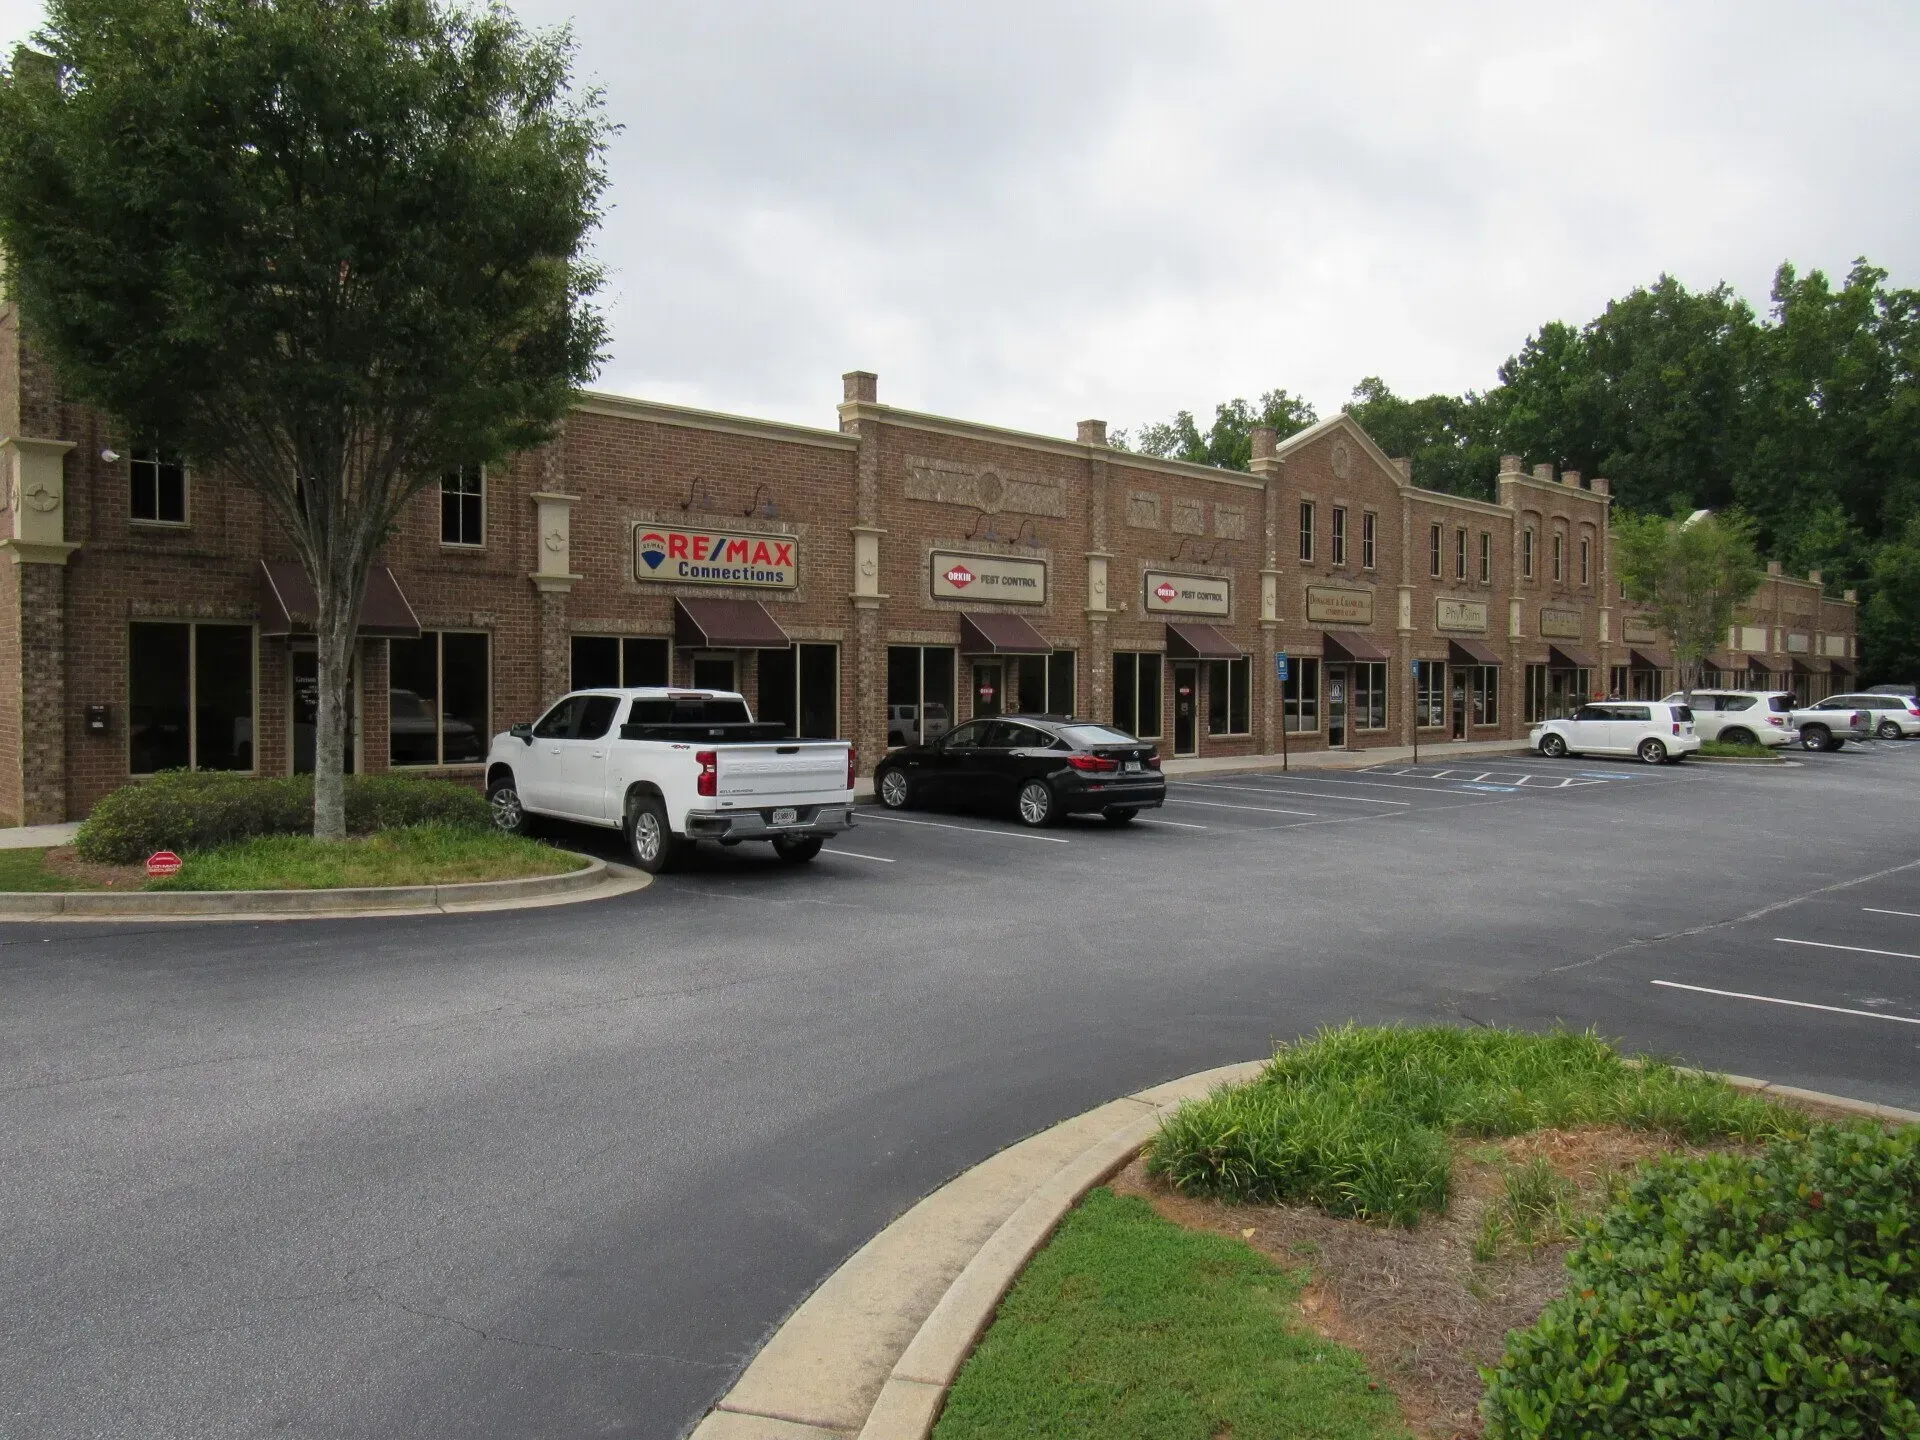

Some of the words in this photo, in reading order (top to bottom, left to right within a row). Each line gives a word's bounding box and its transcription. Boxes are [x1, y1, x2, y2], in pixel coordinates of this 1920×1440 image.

[668, 533, 793, 567] RE/MAX
[678, 561, 784, 582] Connections
[948, 571, 971, 582] ORKIN
[980, 574, 999, 585] PEST
[1002, 577, 1037, 588] CONTROL
[1157, 588, 1175, 597] ORKIN
[1181, 590, 1195, 599] PEST
[1197, 592, 1223, 602] CONTROL
